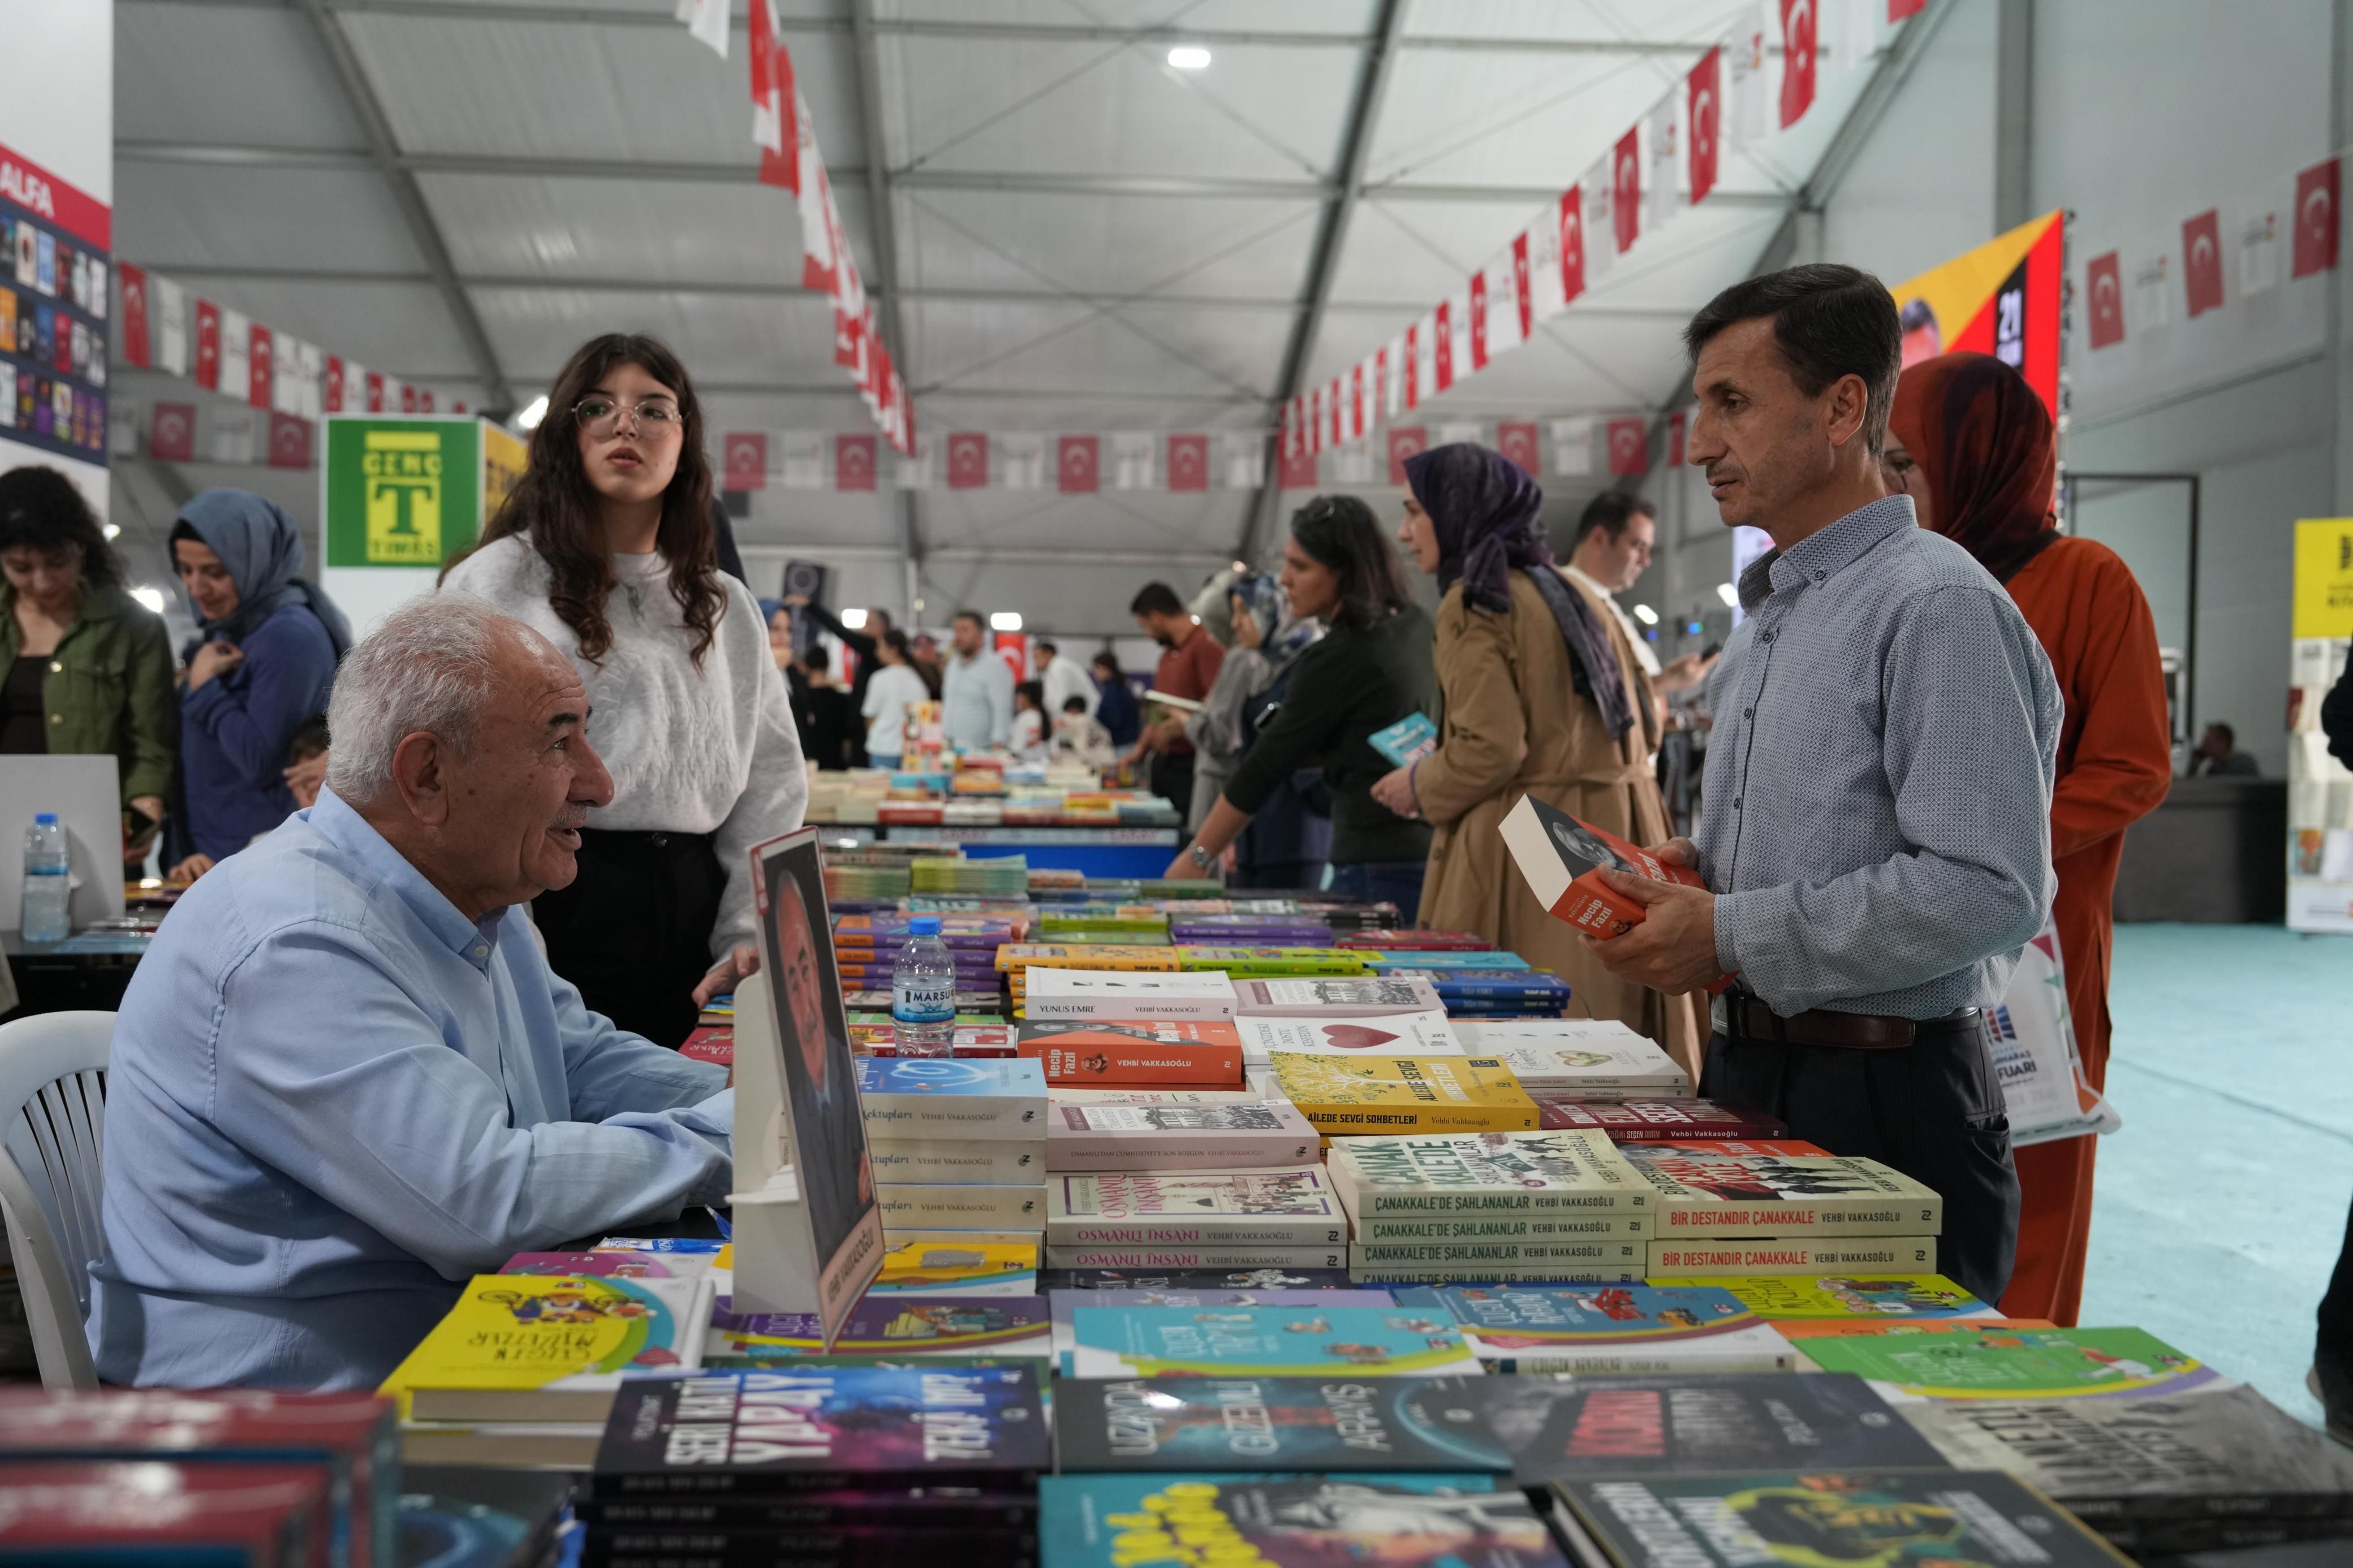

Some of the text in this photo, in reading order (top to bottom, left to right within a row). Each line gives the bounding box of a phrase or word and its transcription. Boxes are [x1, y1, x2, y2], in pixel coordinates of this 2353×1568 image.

[0, 161, 54, 218] ALFA
[1577, 899, 1602, 925] Necip
[1591, 907, 1613, 928] Fazıl
[913, 991, 951, 1001] MARSU
[1157, 1005, 1201, 1013] VAKKASOĞLU
[1278, 1027, 1295, 1044] DOSTU
[1049, 1049, 1061, 1077] Necip
[1063, 1052, 1076, 1074] Fazıl
[1141, 1059, 1192, 1068] VAKKASOĞLU
[1393, 1060, 1439, 1102] AİLEDE SEVGİ
[1428, 1062, 1471, 1102] SOHBETLERİ
[947, 1112, 997, 1121] VAKKASOĞLU
[1307, 1113, 1490, 1126] AİLEDE SEVGİ SOHBETLERİ Vehbi Vakkasoğlu
[1627, 1130, 1644, 1140] SEÇEN
[1644, 1130, 1660, 1139] ADAM
[1347, 1142, 1430, 1186] ÇANAK
[1567, 1135, 1622, 1183] VEHBİ VAKKASOĞLU
[1865, 1178, 1903, 1193] VEHBİ
[1095, 1173, 1130, 1219] OSMANLI
[1375, 1195, 1615, 1211] ÇANAKKALE'DE ŞAHLANANLAR VEHBİ VAKKASOĞLU
[1670, 1210, 1901, 1227] BİR DESTANDIR ÇANAKKALE VEHBİ VAKKASOĞLU
[1078, 1229, 1143, 1242] OSMANLI
[1234, 1231, 1293, 1240] VAKKASOĞLU
[1373, 1221, 1611, 1238] ÇANAKKALE'DE ŞAHLANANLAR VEHBİ VAKKASOĞLU
[1077, 1253, 1142, 1266] OSMANLI
[1205, 1256, 1232, 1264] VEHBİ
[1233, 1255, 1292, 1265] VAKKASOĞLU
[1365, 1246, 1603, 1262] ÇANAKKALE'DE ŞAHLANANLAR VEHBİ VAKKASOĞLU
[1662, 1251, 1894, 1268] BİR DESTANDIR ÇANAKKALE VEHBİ VAKKASOĞLU
[730, 1373, 835, 1465] YAPAY
